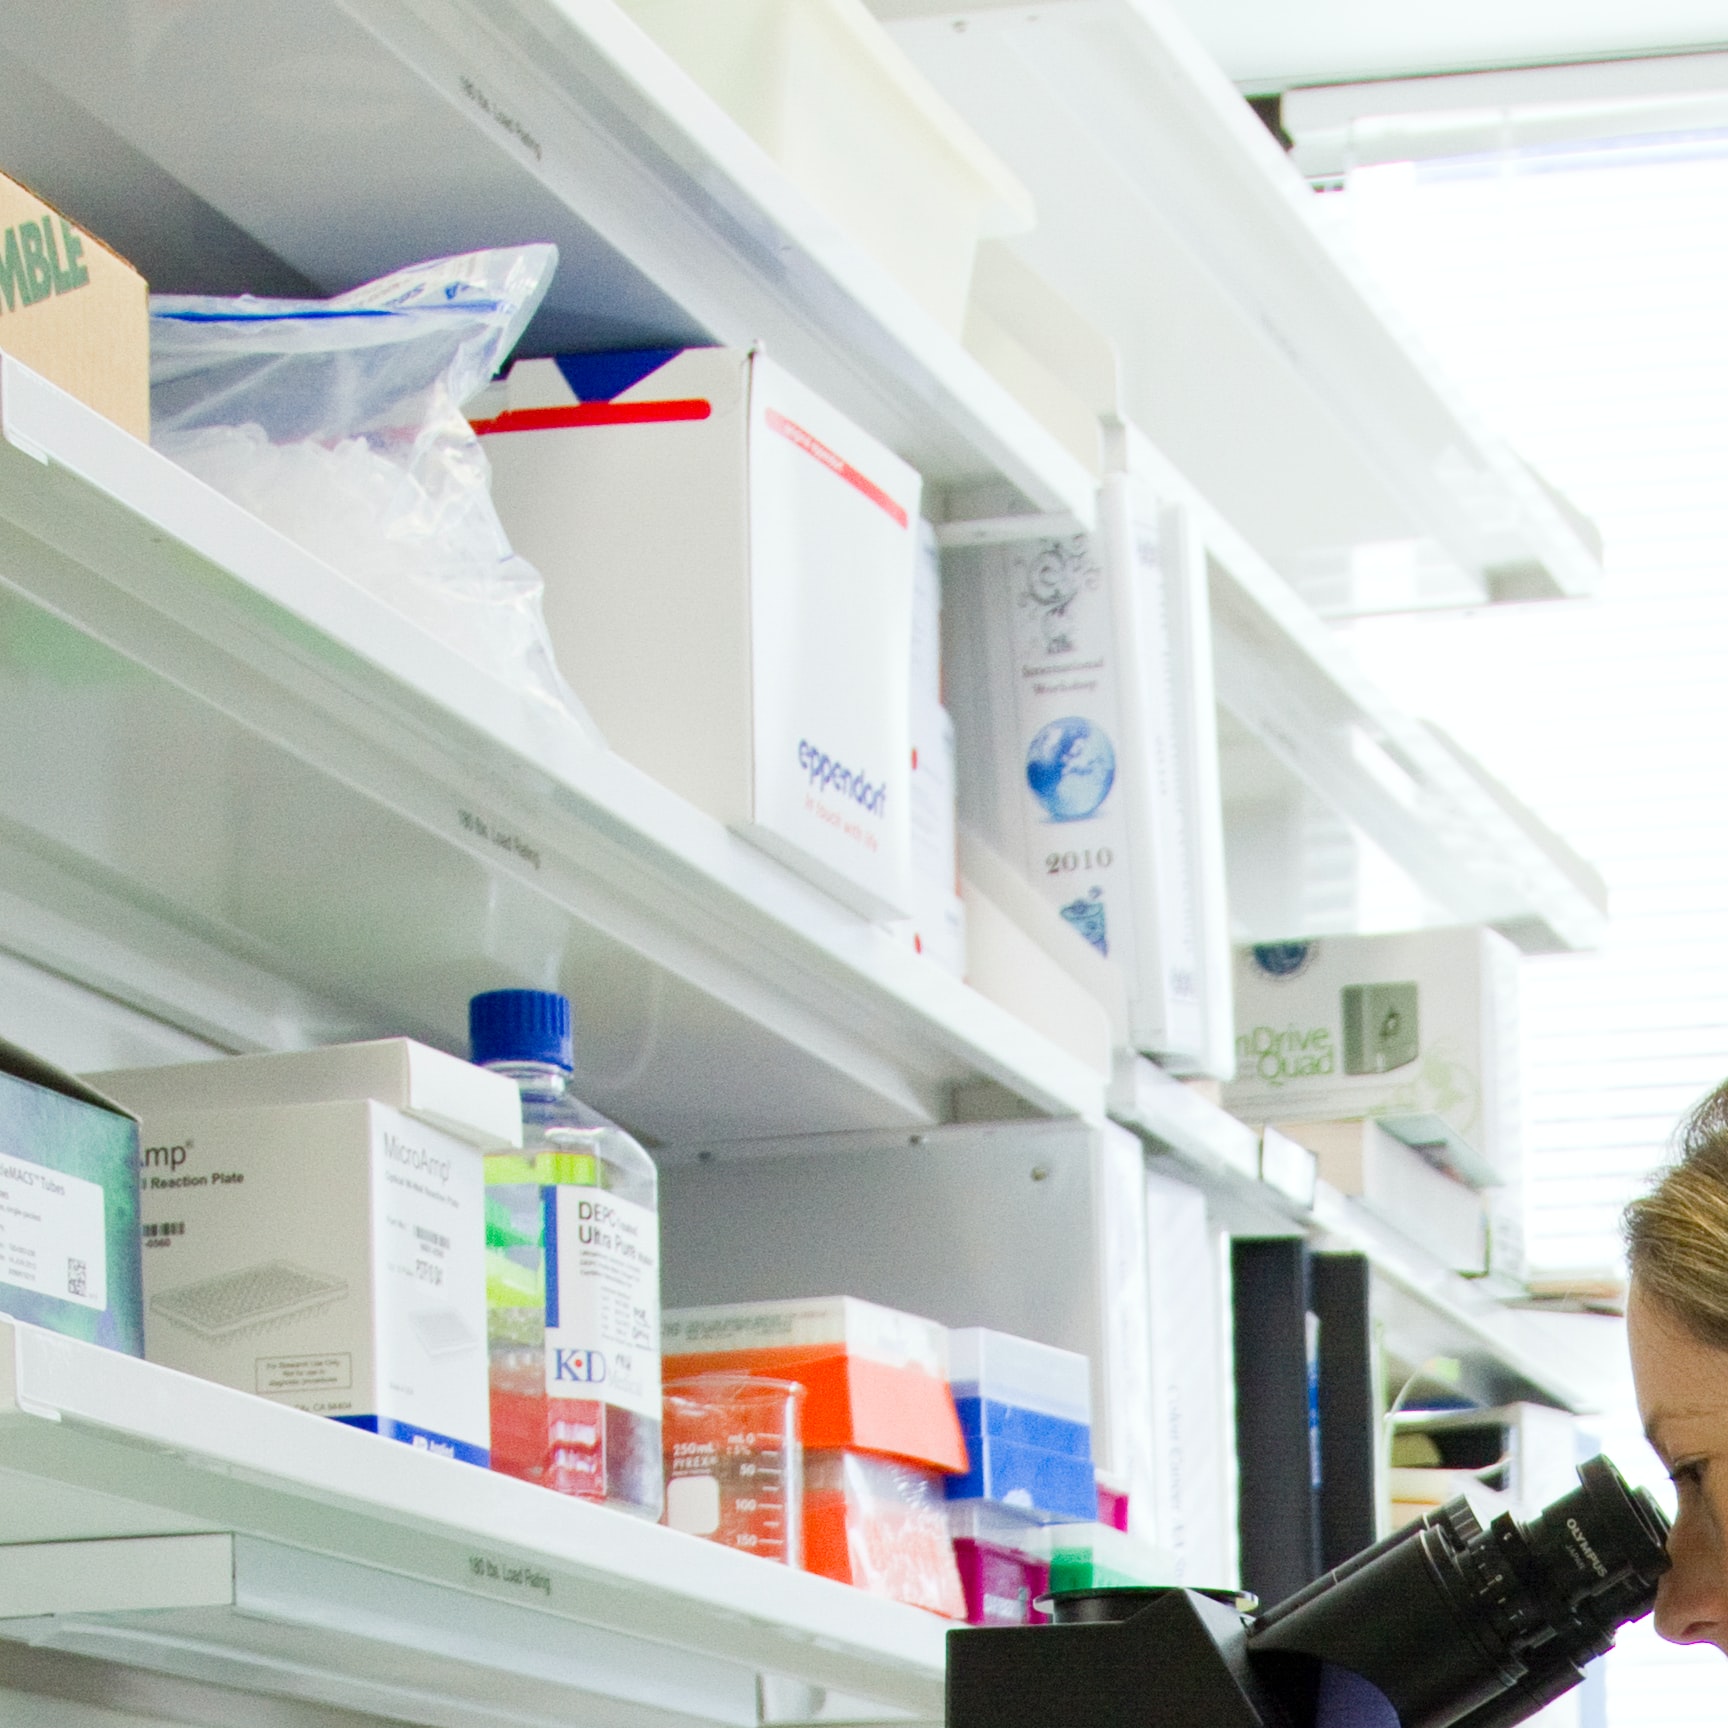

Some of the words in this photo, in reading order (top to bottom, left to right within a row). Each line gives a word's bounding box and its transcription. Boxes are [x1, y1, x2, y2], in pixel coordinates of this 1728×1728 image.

[798, 737, 886, 820] eppendorf
[1045, 847, 1115, 875] 2010
[1256, 1044, 1335, 1088] Quad
[150, 1176, 208, 1190] Reaction
[211, 1172, 245, 1186] Plate
[739, 1463, 756, 1477] 50
[735, 1499, 757, 1512] 100
[736, 1533, 758, 1547] 150
[1566, 1517, 1608, 1578] OLYMPUS
